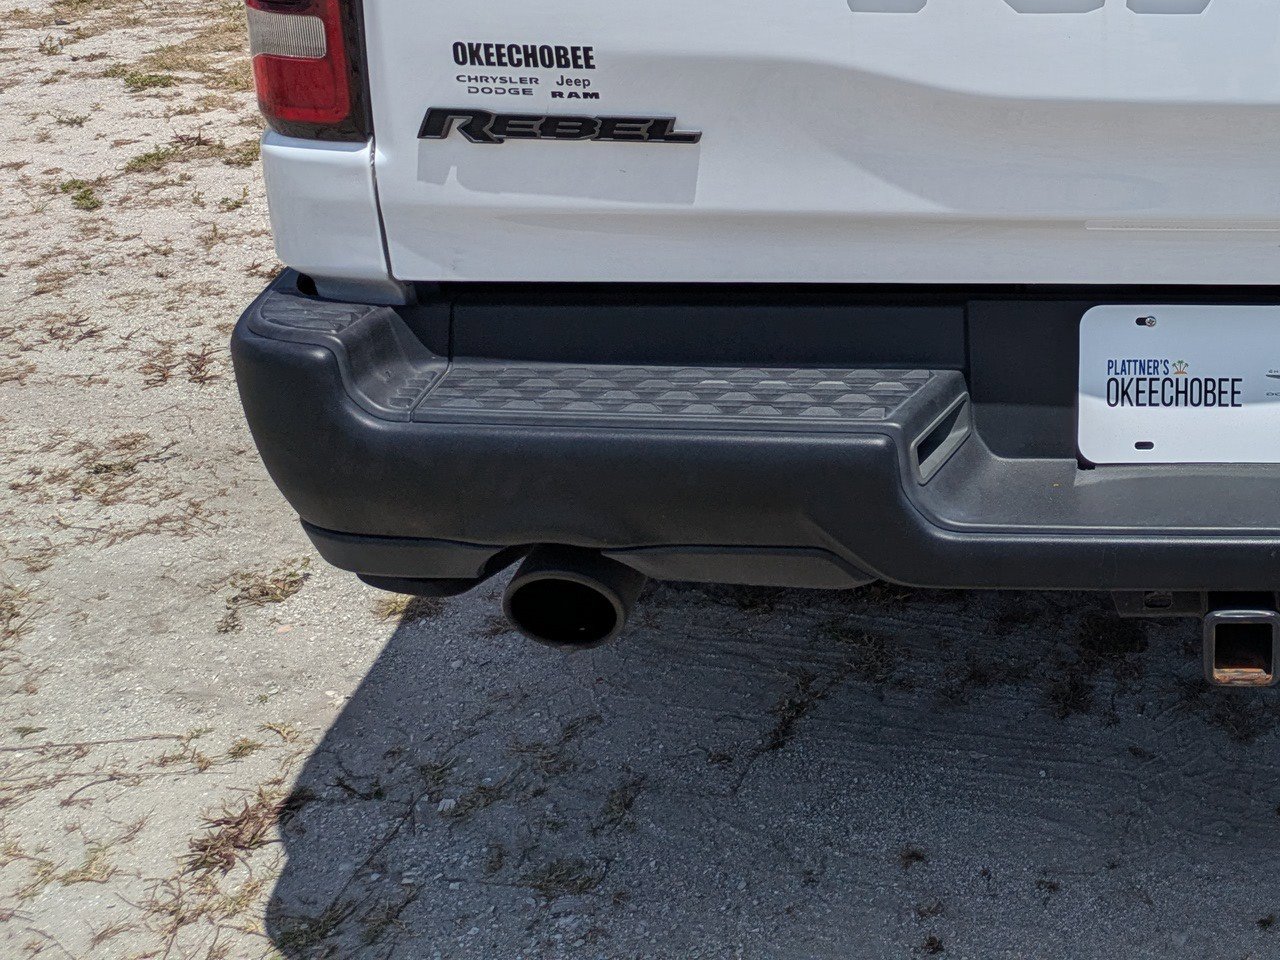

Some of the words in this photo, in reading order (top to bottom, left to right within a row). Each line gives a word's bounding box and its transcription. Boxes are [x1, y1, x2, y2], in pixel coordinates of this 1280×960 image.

[452, 41, 596, 70] OKEECHOBEE
[456, 74, 540, 86] CHRYSLER
[555, 74, 592, 89] Jeep
[467, 86, 534, 96] DODGE
[551, 90, 600, 100] RAM
[417, 106, 703, 145] REBEL
[1107, 358, 1170, 377] PLATTNER'S
[1106, 377, 1243, 408] OKEECHOBEE
